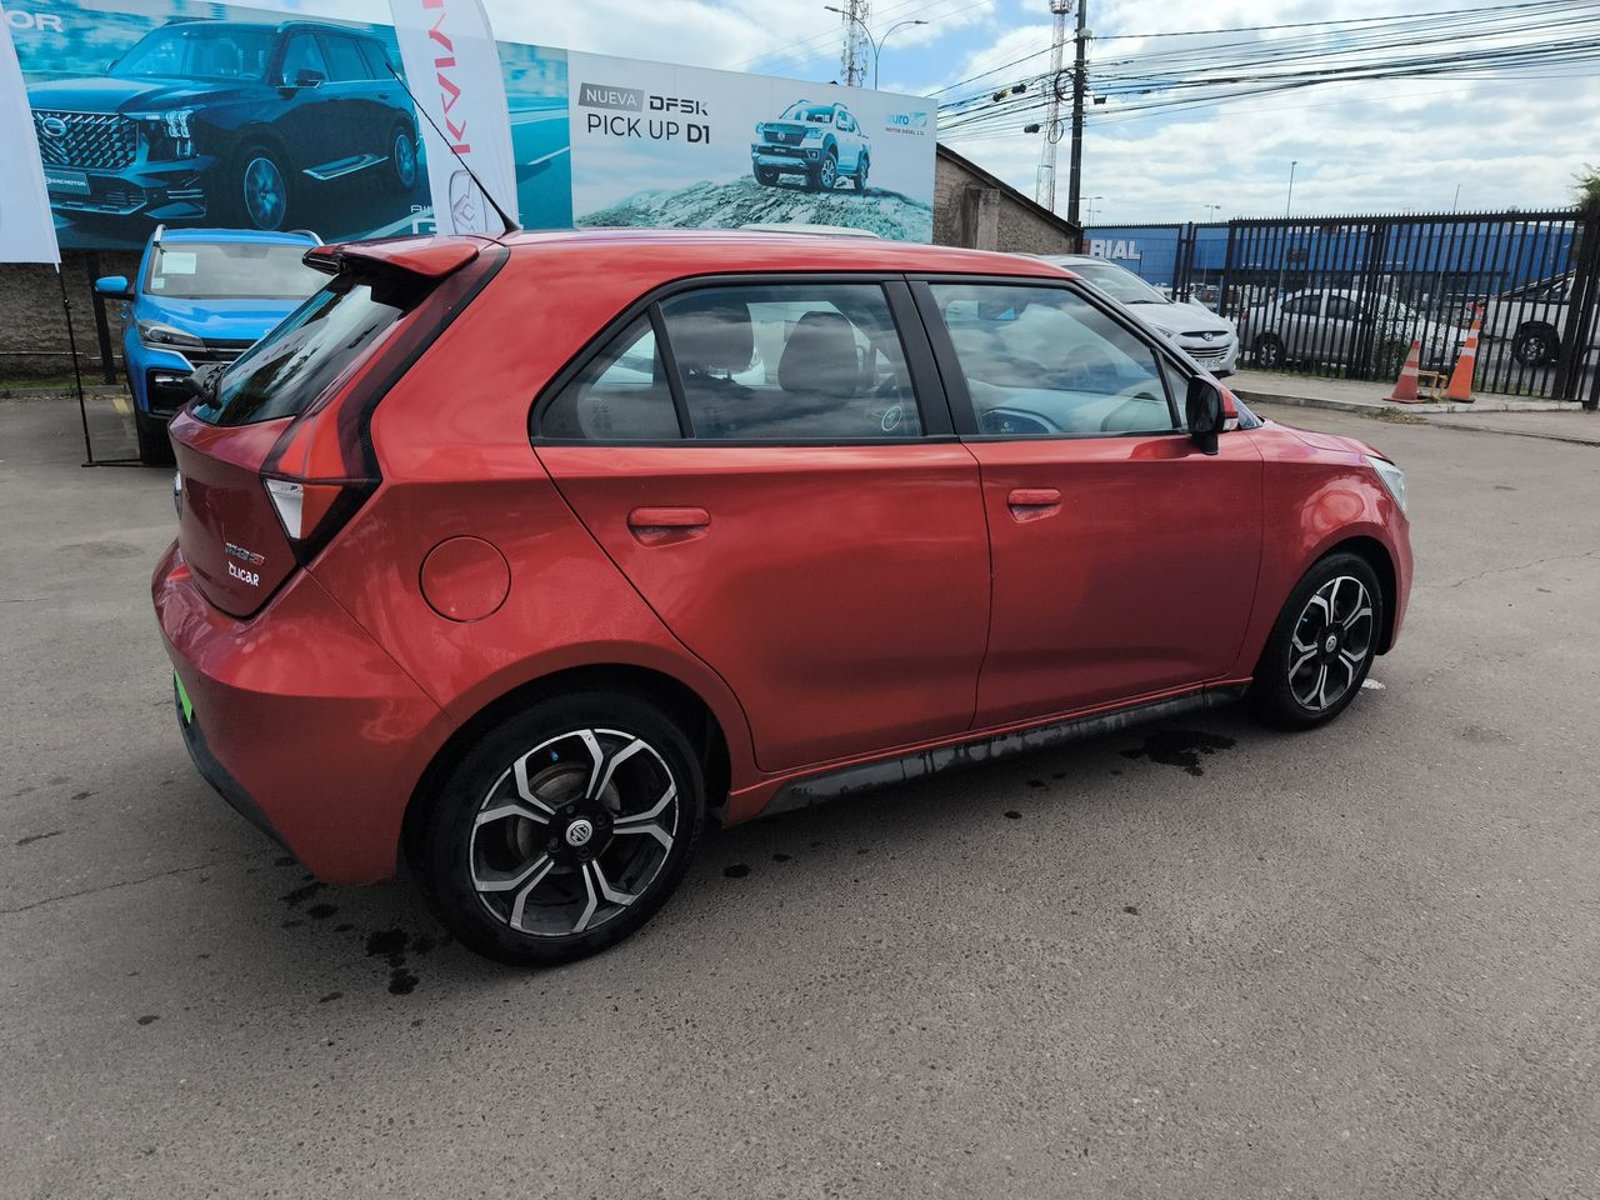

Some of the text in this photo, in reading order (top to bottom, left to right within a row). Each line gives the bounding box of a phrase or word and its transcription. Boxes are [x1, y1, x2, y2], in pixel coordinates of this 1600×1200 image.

[5, 9, 64, 33] OR
[585, 88, 709, 117] NUEVA DFSK
[586, 113, 710, 145] PICK UP D1
